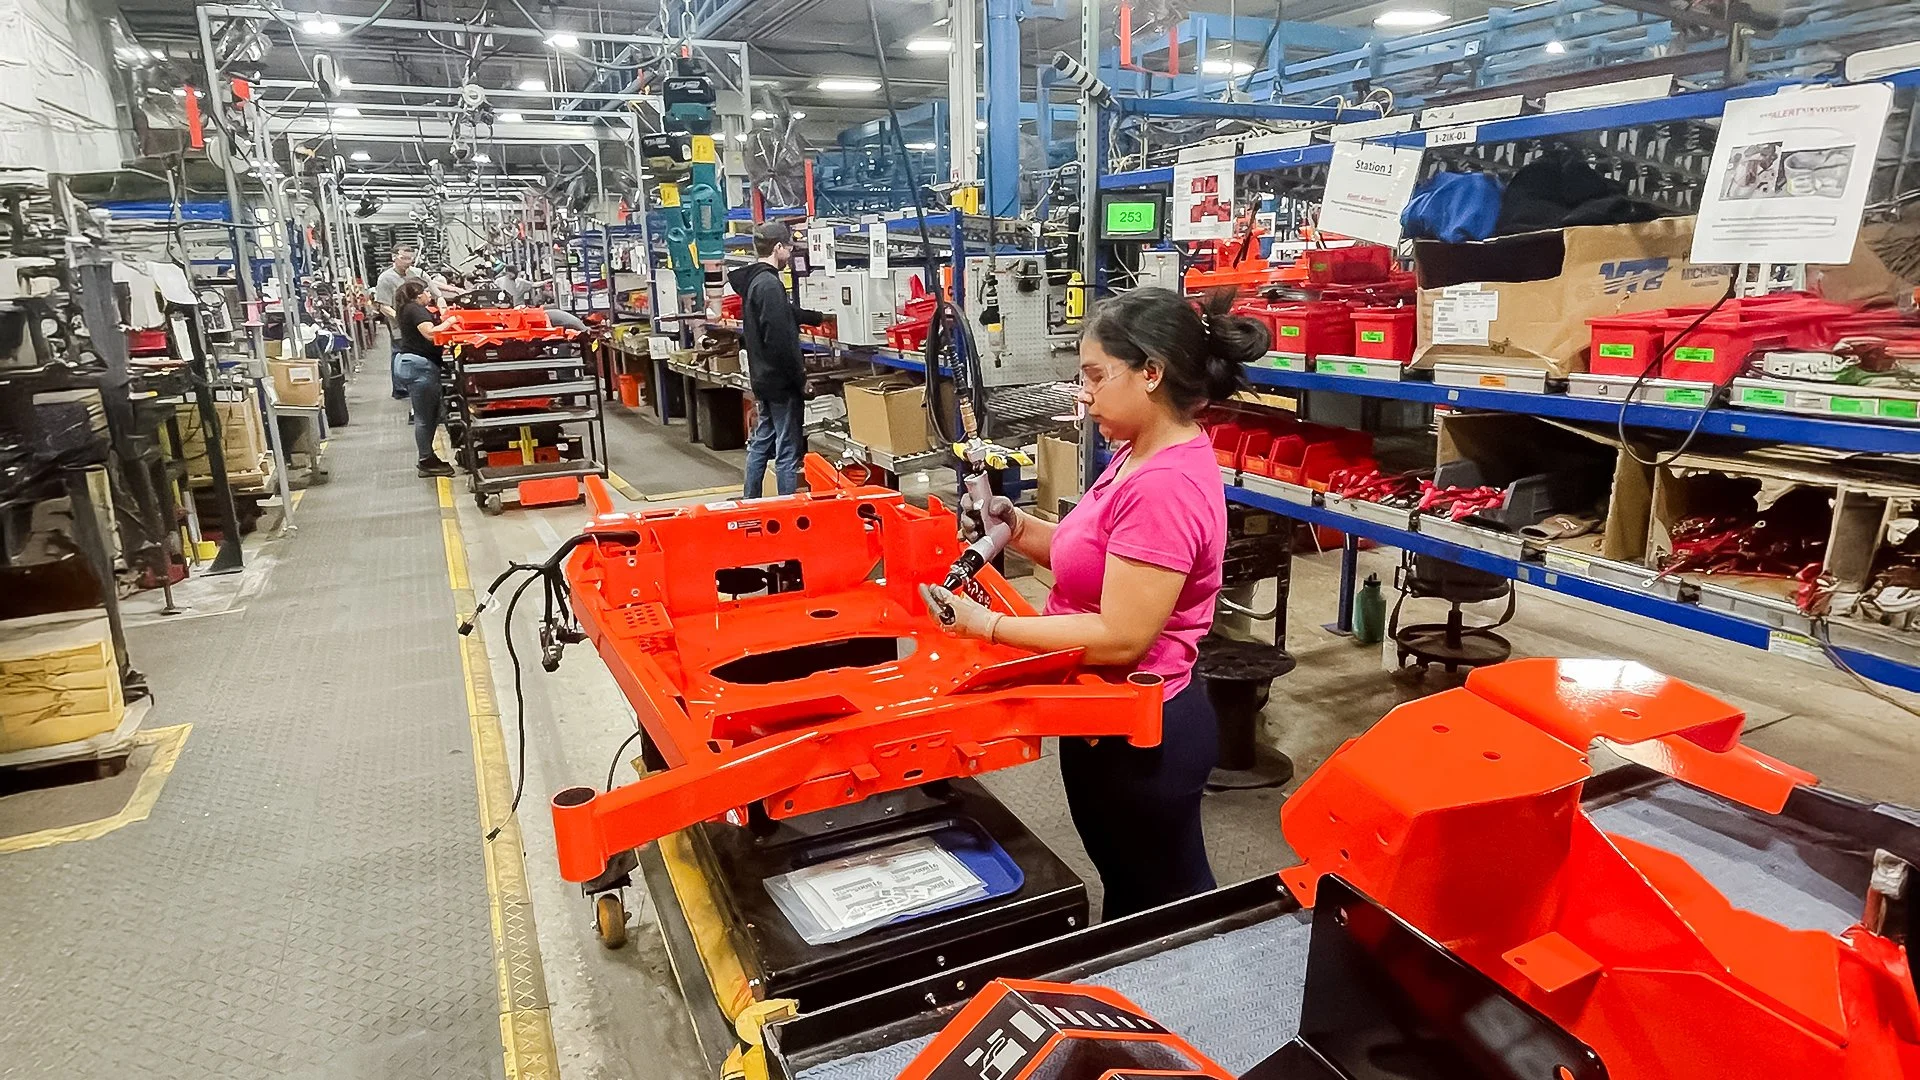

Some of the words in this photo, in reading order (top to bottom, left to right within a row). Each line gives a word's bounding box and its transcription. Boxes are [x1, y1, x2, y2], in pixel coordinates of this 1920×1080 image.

[1355, 159, 1386, 173] Station
[1387, 164, 1393, 174] 1
[1119, 211, 1142, 223] 253
